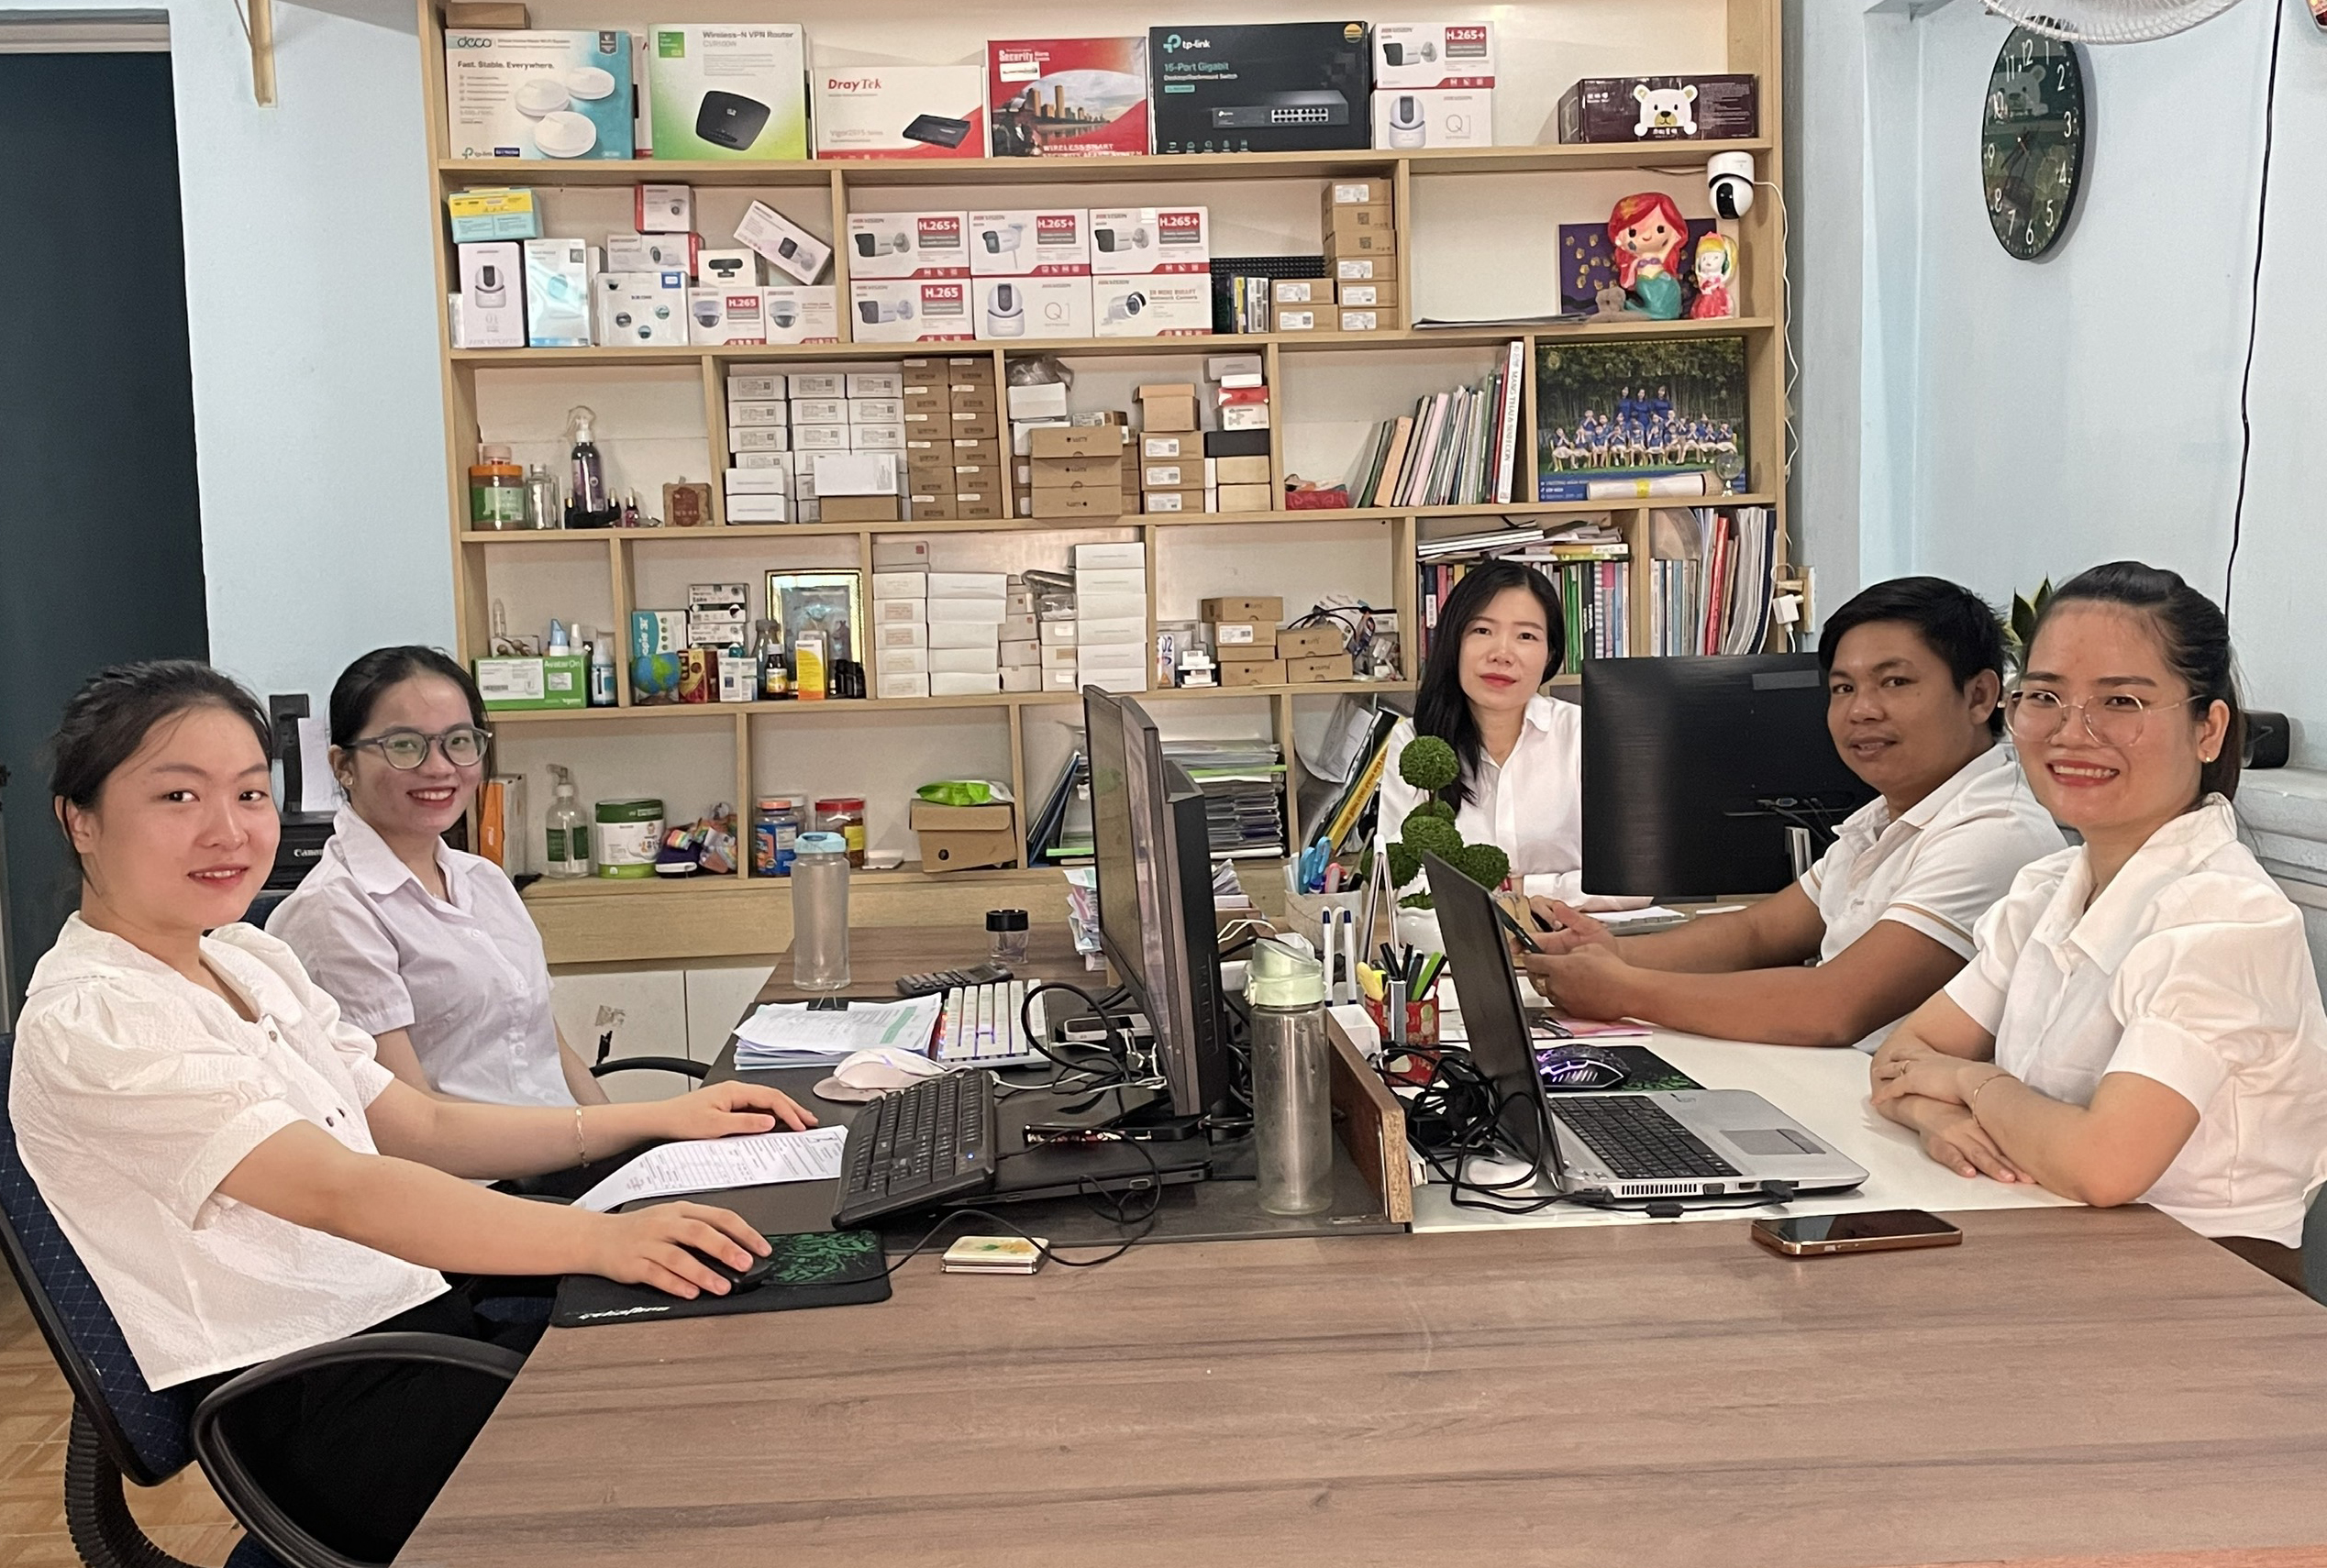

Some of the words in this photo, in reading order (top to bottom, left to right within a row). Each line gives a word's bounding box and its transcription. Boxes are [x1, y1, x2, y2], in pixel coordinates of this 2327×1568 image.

[457, 37, 493, 49] deco
[1182, 39, 1211, 50] tp-link
[1446, 29, 1485, 40] H.265+
[2022, 39, 2033, 67] 12
[2044, 41, 2050, 65] 1
[2005, 54, 2016, 83] 11
[2057, 63, 2066, 92] 2
[1993, 91, 2004, 119] 10
[2064, 111, 2072, 138] 3
[1988, 143, 1995, 168] 9
[2058, 160, 2067, 183] 4
[1994, 188, 2003, 213] 8
[2046, 199, 2054, 226] 5
[918, 221, 959, 231] H.265+
[1037, 219, 1075, 228] H.265+
[1159, 216, 1199, 226] H.265+
[2008, 209, 2016, 236] 7
[2025, 219, 2034, 245] 6
[727, 298, 757, 307] H.265
[925, 287, 959, 298] H.265
[569, 659, 581, 668] On
